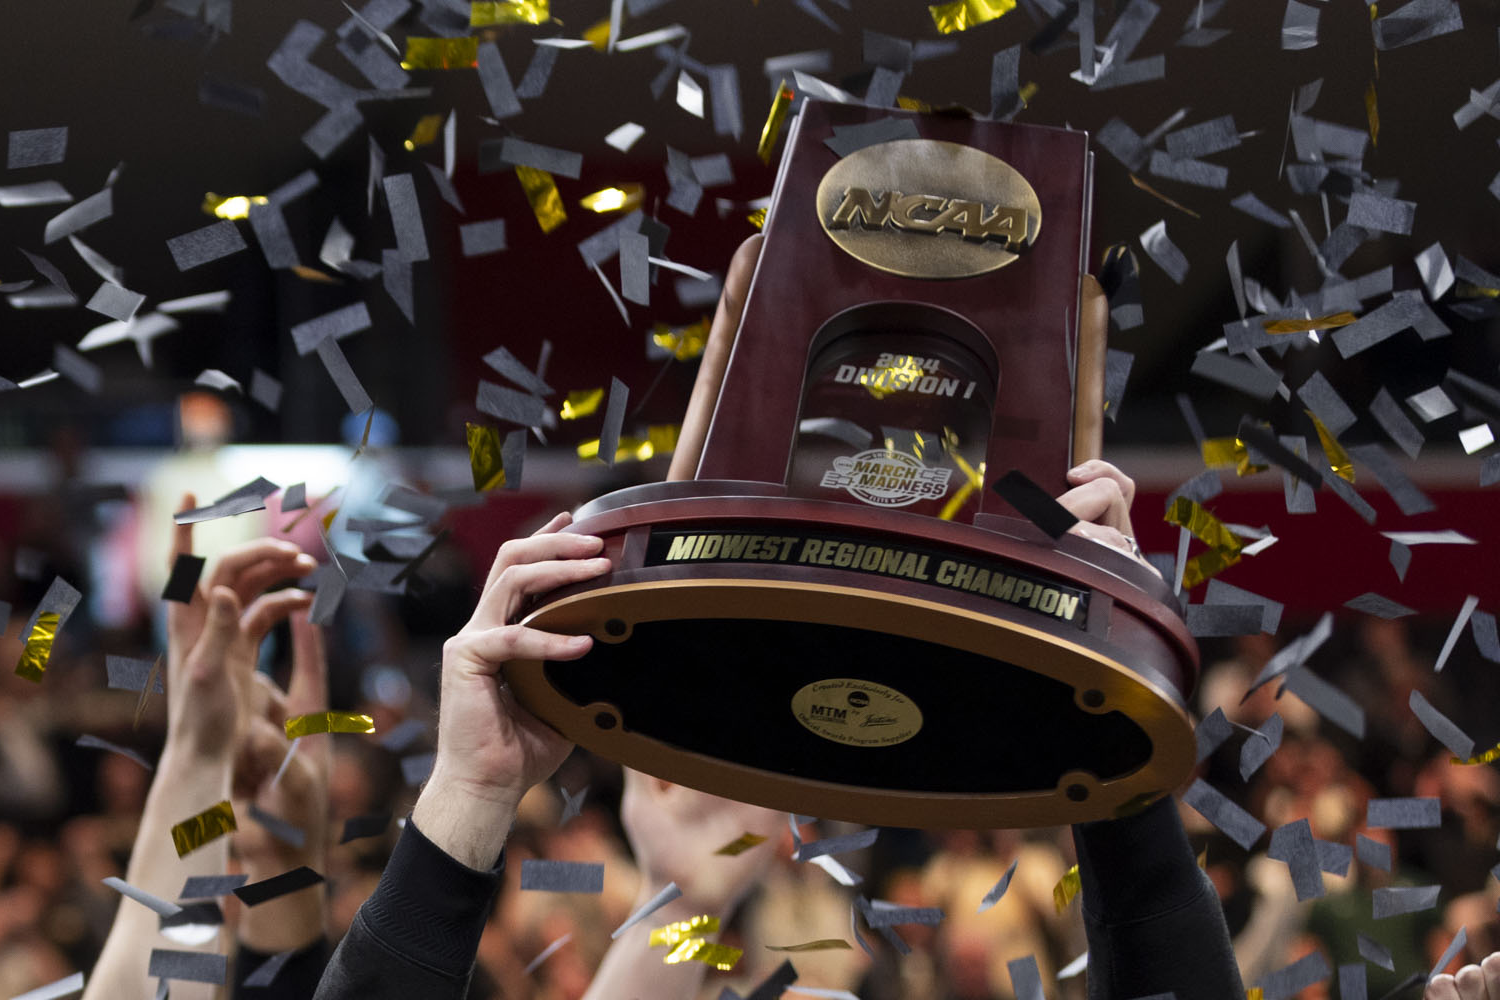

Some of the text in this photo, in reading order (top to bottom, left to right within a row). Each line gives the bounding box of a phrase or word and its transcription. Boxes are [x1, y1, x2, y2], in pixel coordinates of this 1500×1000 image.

[832, 186, 1030, 252] NCAA
[834, 364, 960, 397] DIVISION
[852, 461, 918, 480] MARCH
[858, 473, 945, 496] MADNESS
[665, 535, 1080, 620] MIDWEST REGIONAL CHAMPION
[811, 704, 848, 719] MTM
